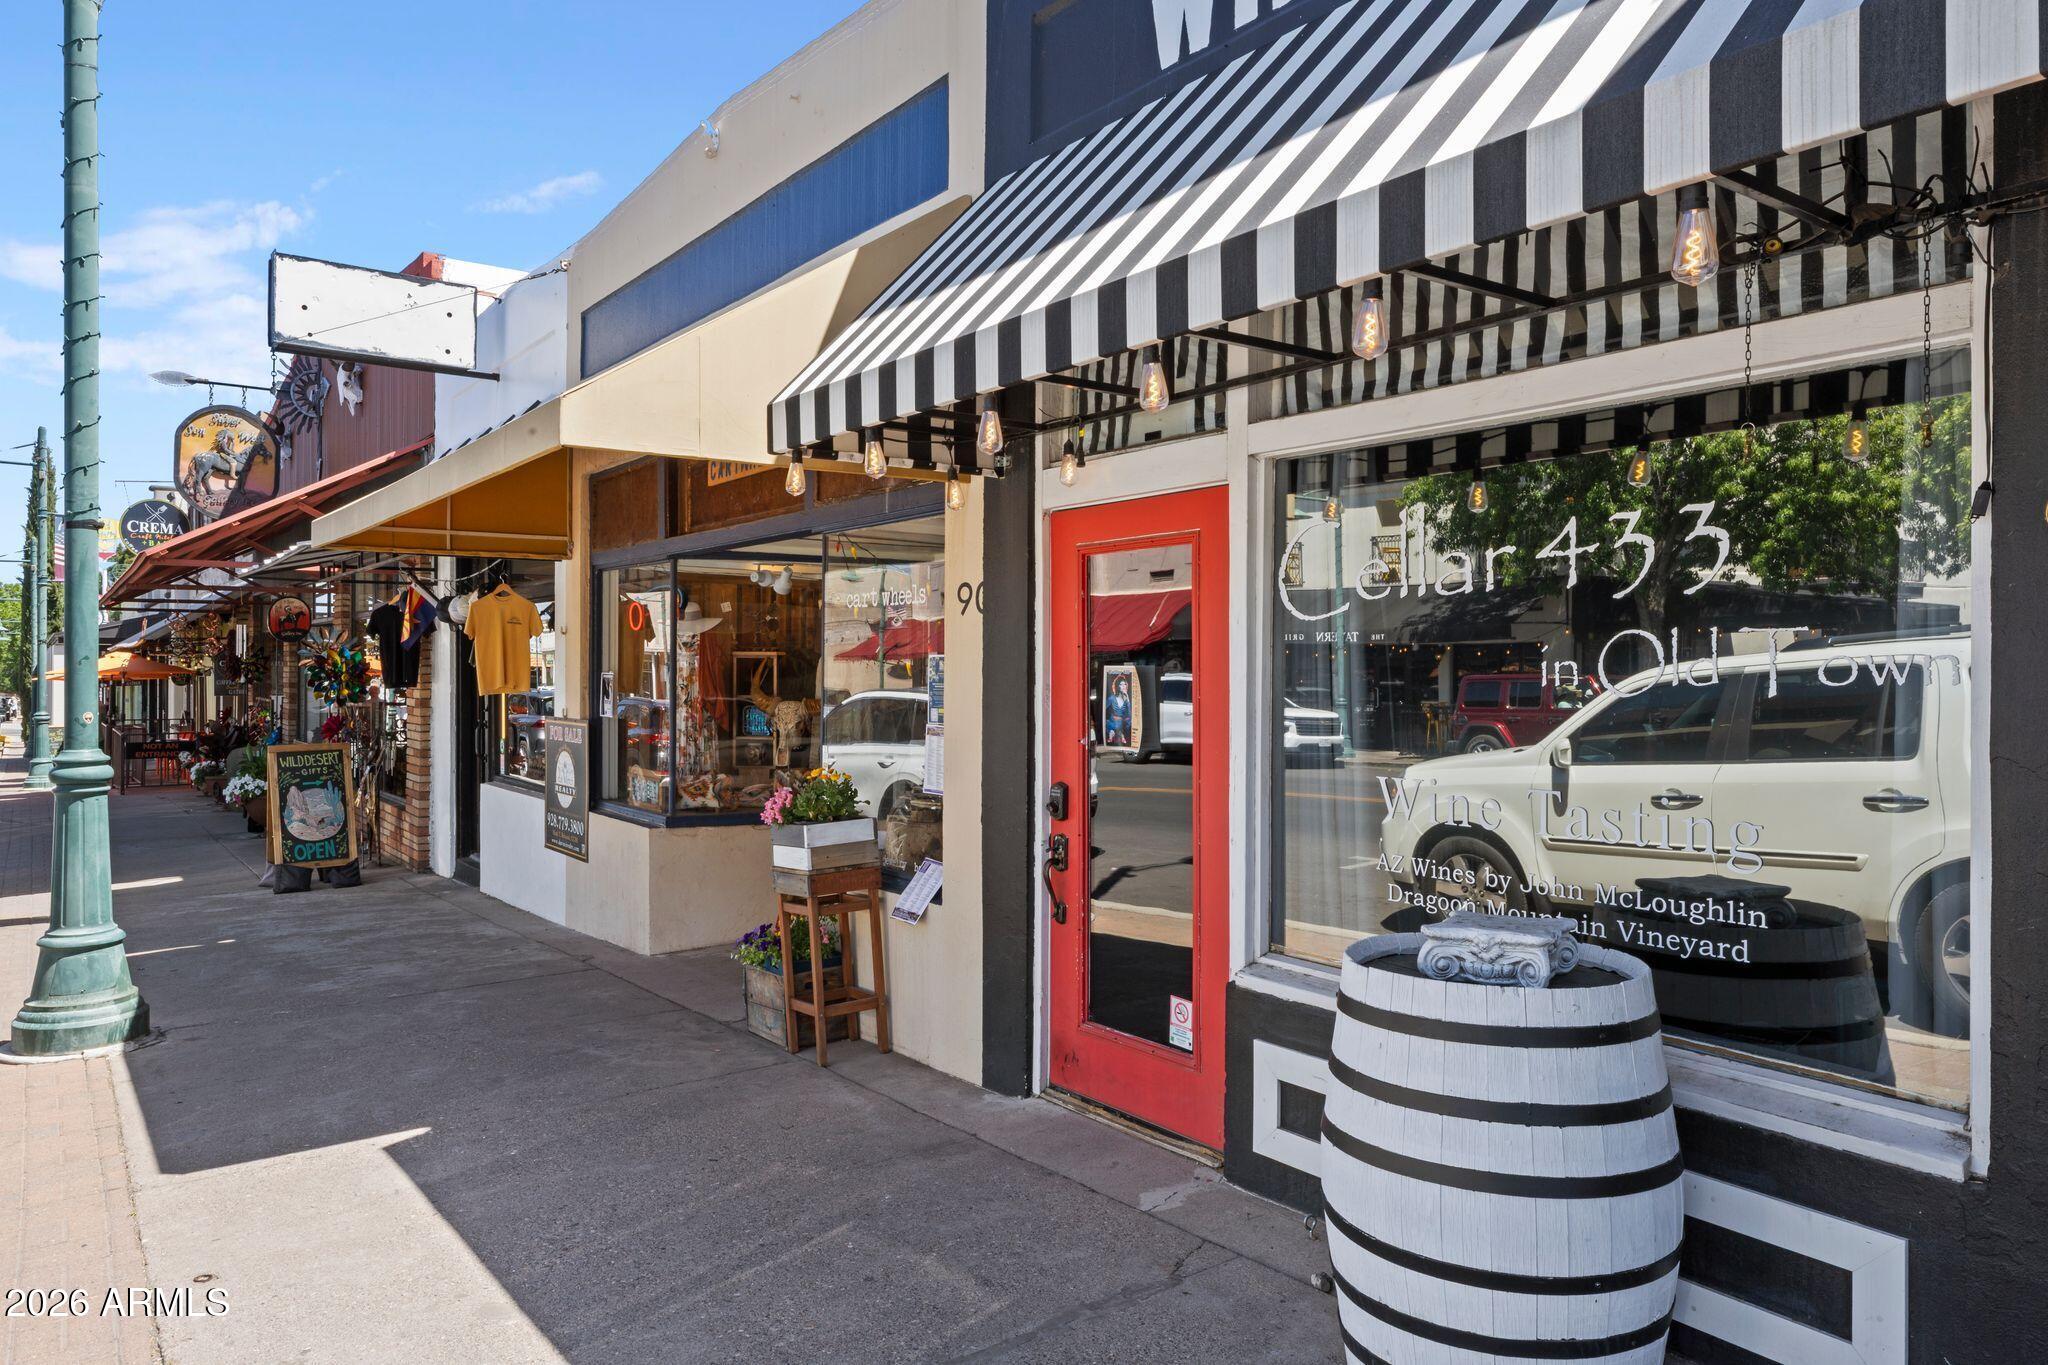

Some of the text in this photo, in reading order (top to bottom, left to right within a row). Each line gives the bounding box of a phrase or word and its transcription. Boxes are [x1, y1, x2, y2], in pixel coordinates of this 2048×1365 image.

[127, 519, 183, 536] CREMA
[1279, 500, 1730, 621] Cellar 433
[846, 583, 926, 609] cart wheels
[1541, 626, 1961, 699] in Old Town
[550, 725, 582, 744] FOR SALE
[301, 767, 328, 775] GIFTS
[554, 785, 576, 798] REALTY
[1376, 776, 1764, 875] Wine Tasting
[294, 841, 337, 860] OPEN
[1376, 852, 1769, 930] AZ Wines by John McLoughlin
[1387, 883, 1477, 914] Dragoon
[1616, 919, 1751, 963] Vineyard
